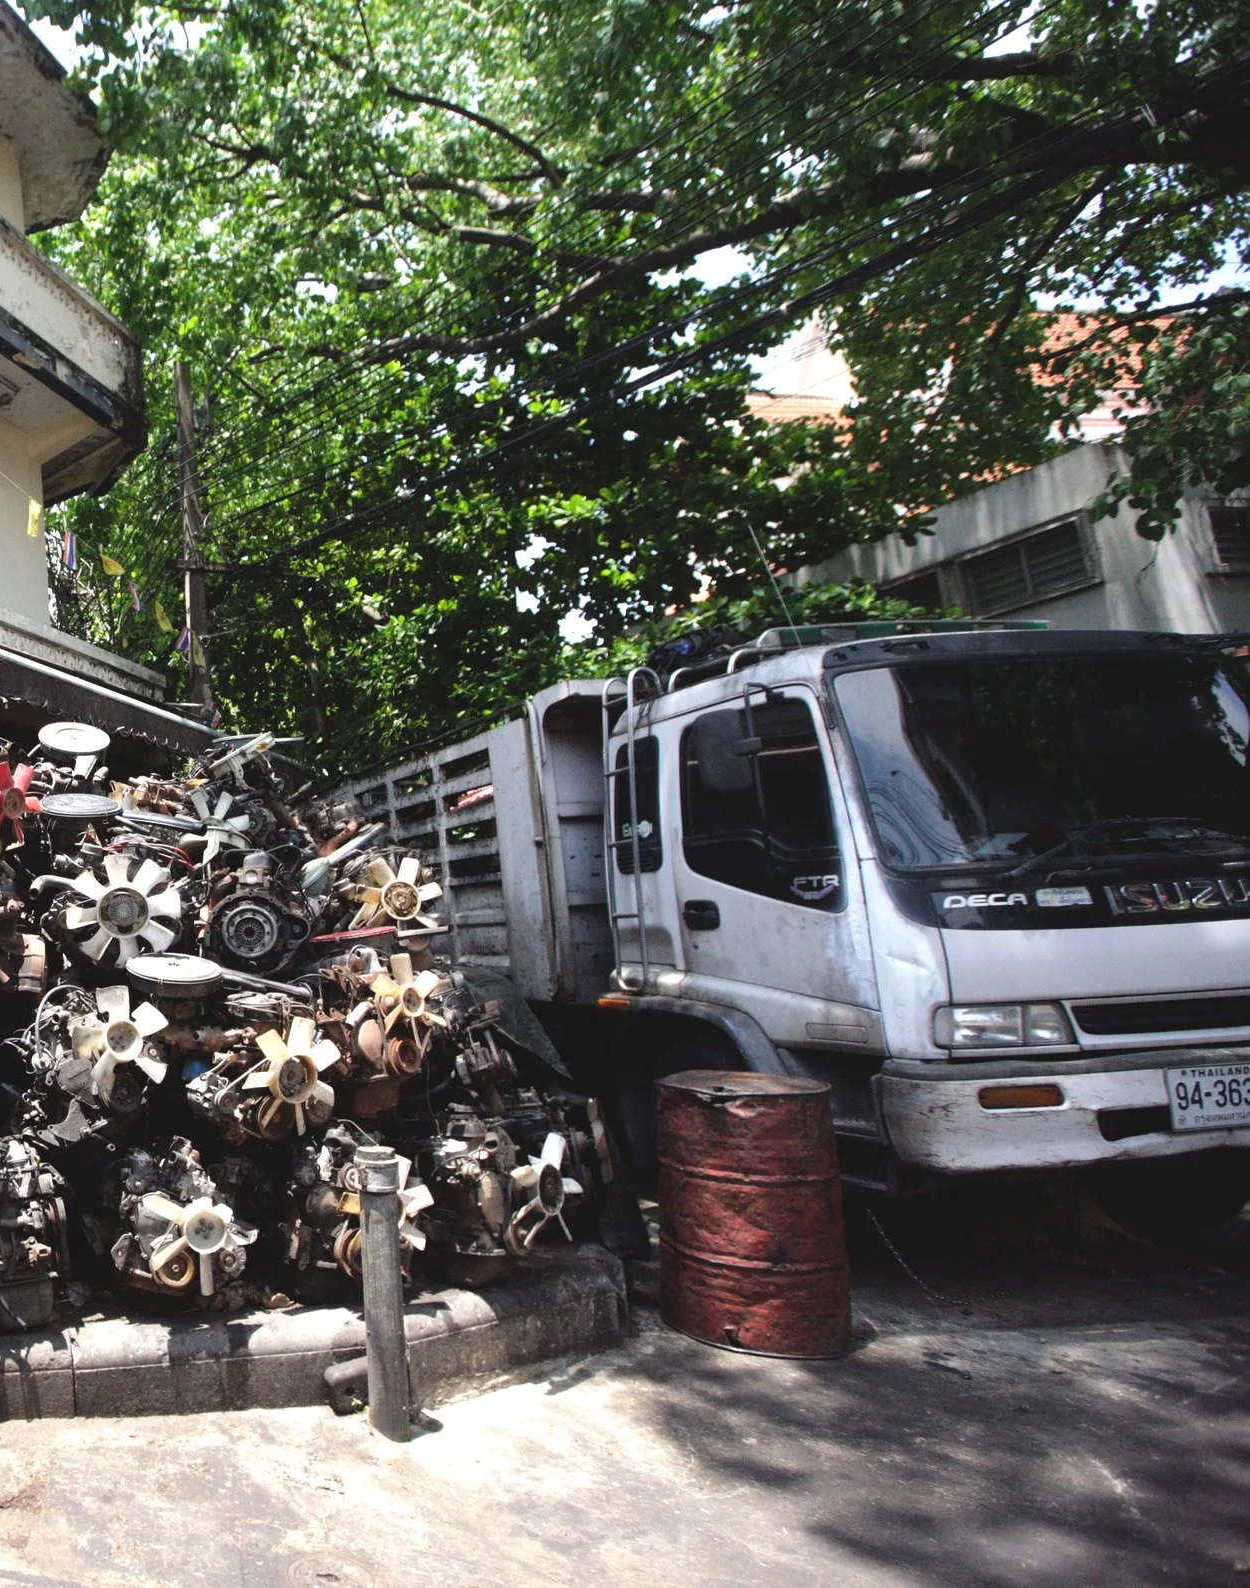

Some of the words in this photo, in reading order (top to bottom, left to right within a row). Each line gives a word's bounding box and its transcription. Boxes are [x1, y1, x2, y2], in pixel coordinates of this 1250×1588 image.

[793, 874, 840, 889] FTR
[943, 893, 1028, 909] DECA
[1103, 878, 1250, 916] ISUZU
[1190, 1066, 1250, 1078] THAILAND
